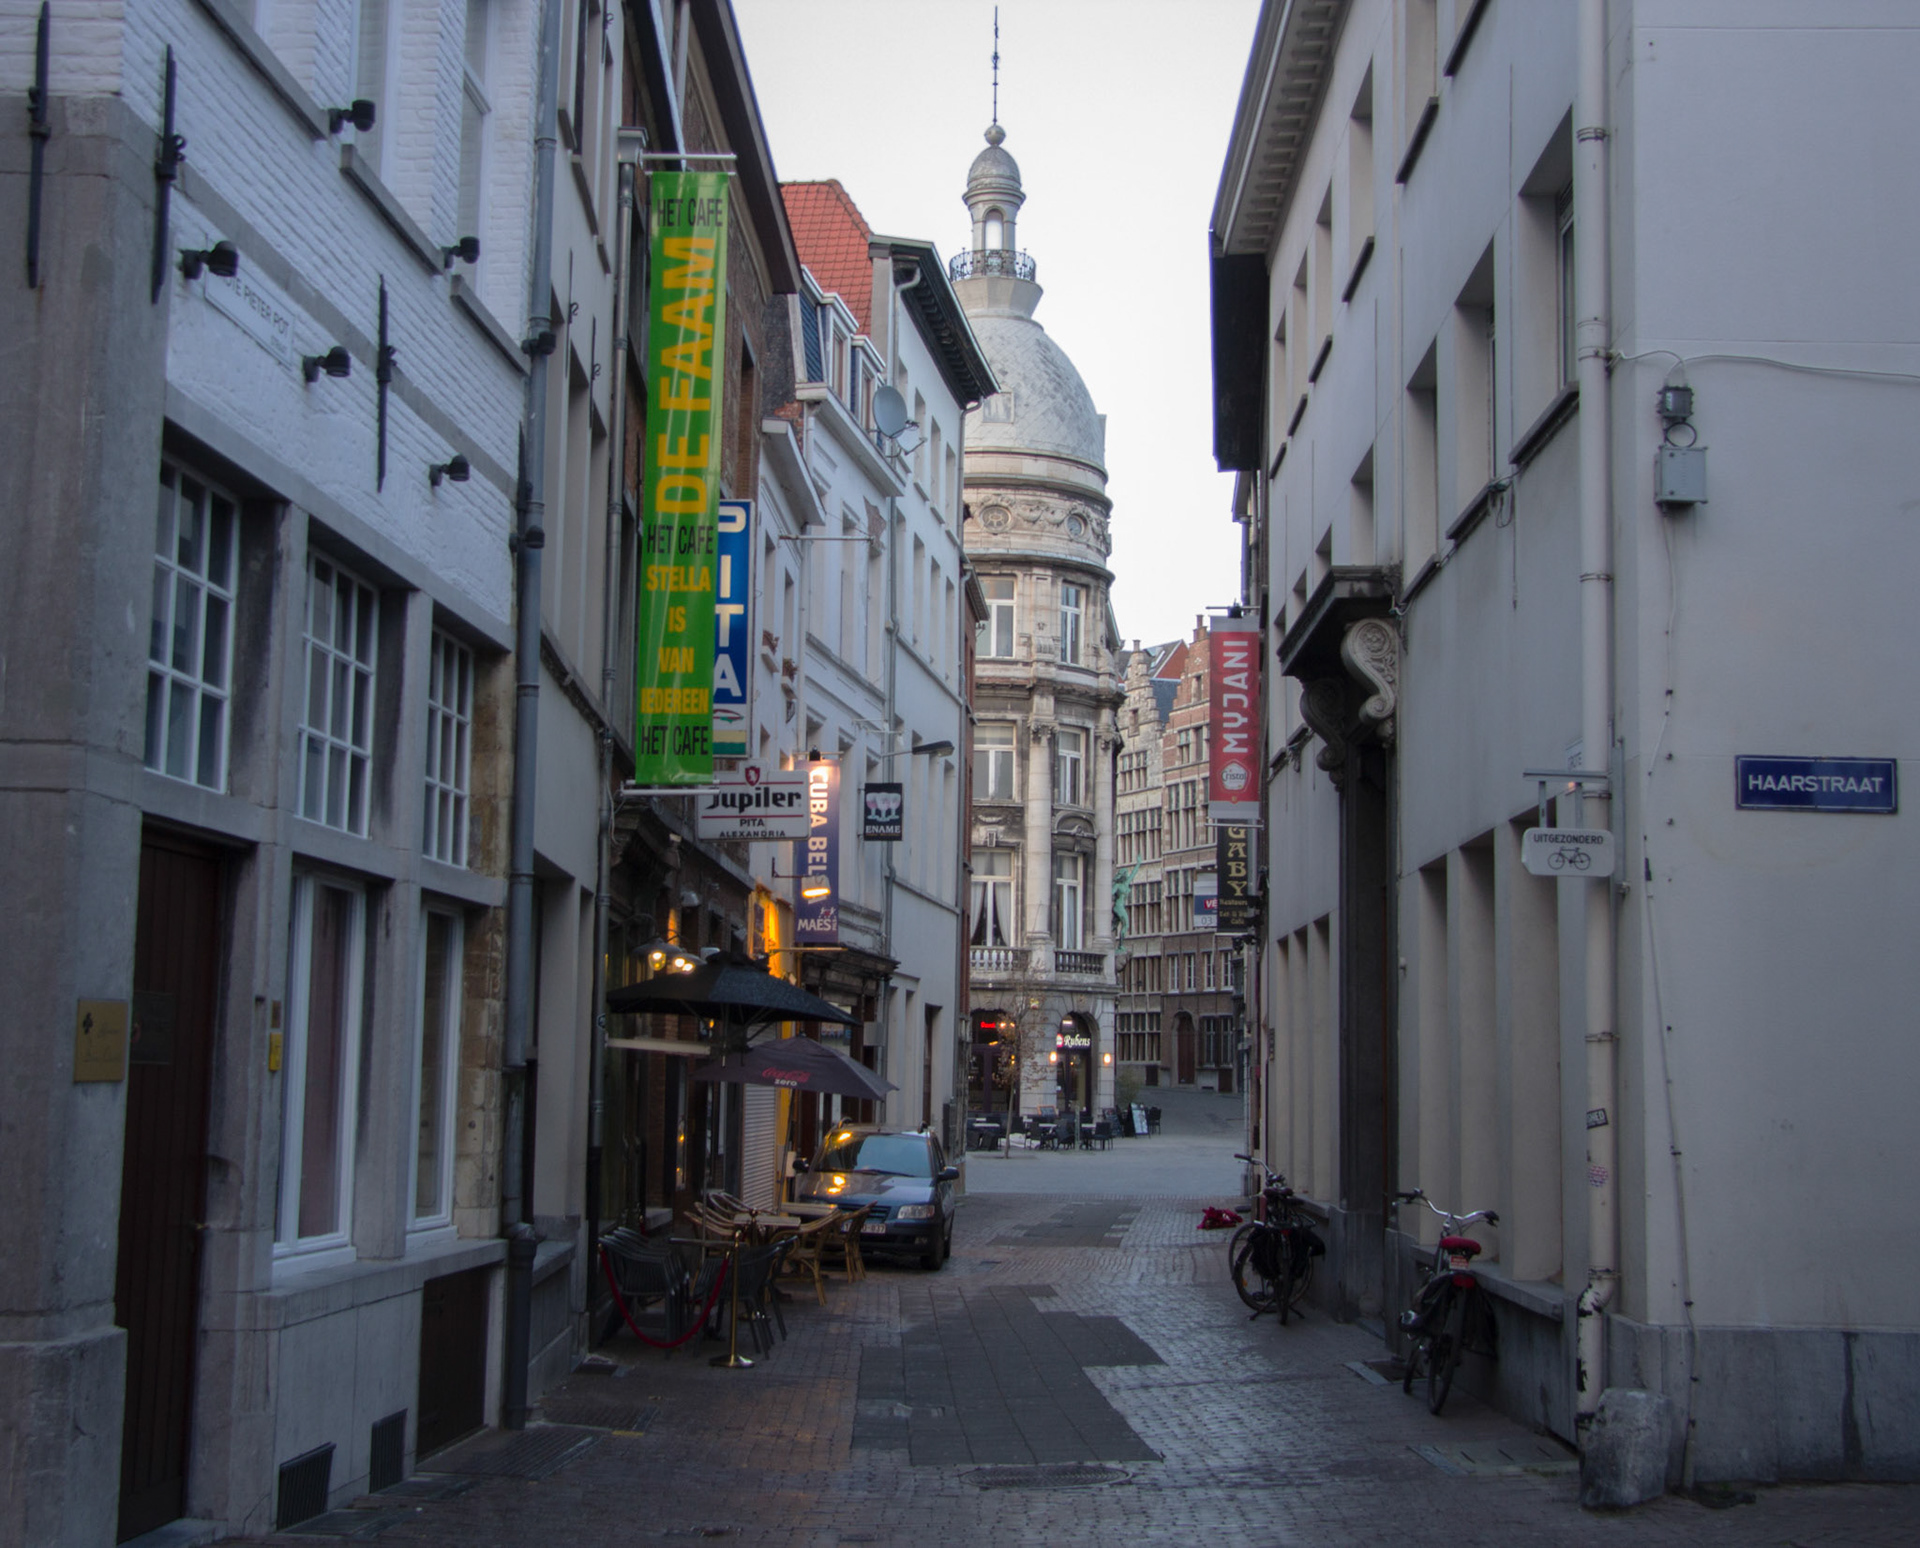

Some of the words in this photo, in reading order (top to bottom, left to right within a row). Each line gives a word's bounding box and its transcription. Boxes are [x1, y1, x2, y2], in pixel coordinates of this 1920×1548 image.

[656, 198, 683, 227] HET
[687, 197, 723, 227] CAFE
[244, 285, 271, 322] PIETER
[273, 311, 289, 337] POT
[659, 236, 715, 412] FAAM
[655, 433, 710, 514] DE
[647, 524, 673, 555] HET
[678, 525, 714, 555] CAFE
[646, 565, 711, 592] STELLA
[713, 505, 747, 698] PITA
[668, 606, 686, 633] IS
[658, 646, 694, 674] VAN
[641, 687, 709, 715] IEDEREEN
[1223, 640, 1249, 753] MYJANI
[641, 725, 668, 755] HET
[673, 725, 709, 755] CAFE
[1221, 770, 1247, 782] Cristal
[1747, 773, 1884, 794] HAARSTRAAT
[705, 787, 802, 814] Jupiler
[808, 765, 829, 828] CUBA
[719, 830, 786, 838] ALEXANDRIA
[739, 818, 765, 827] PITA
[865, 825, 901, 833] ENAME
[1533, 833, 1604, 845] UITGEZONDERD
[1226, 826, 1248, 897] GABY
[797, 918, 832, 931] MAES
[1064, 1033, 1091, 1048] Rubens
[774, 1078, 798, 1087] zero
